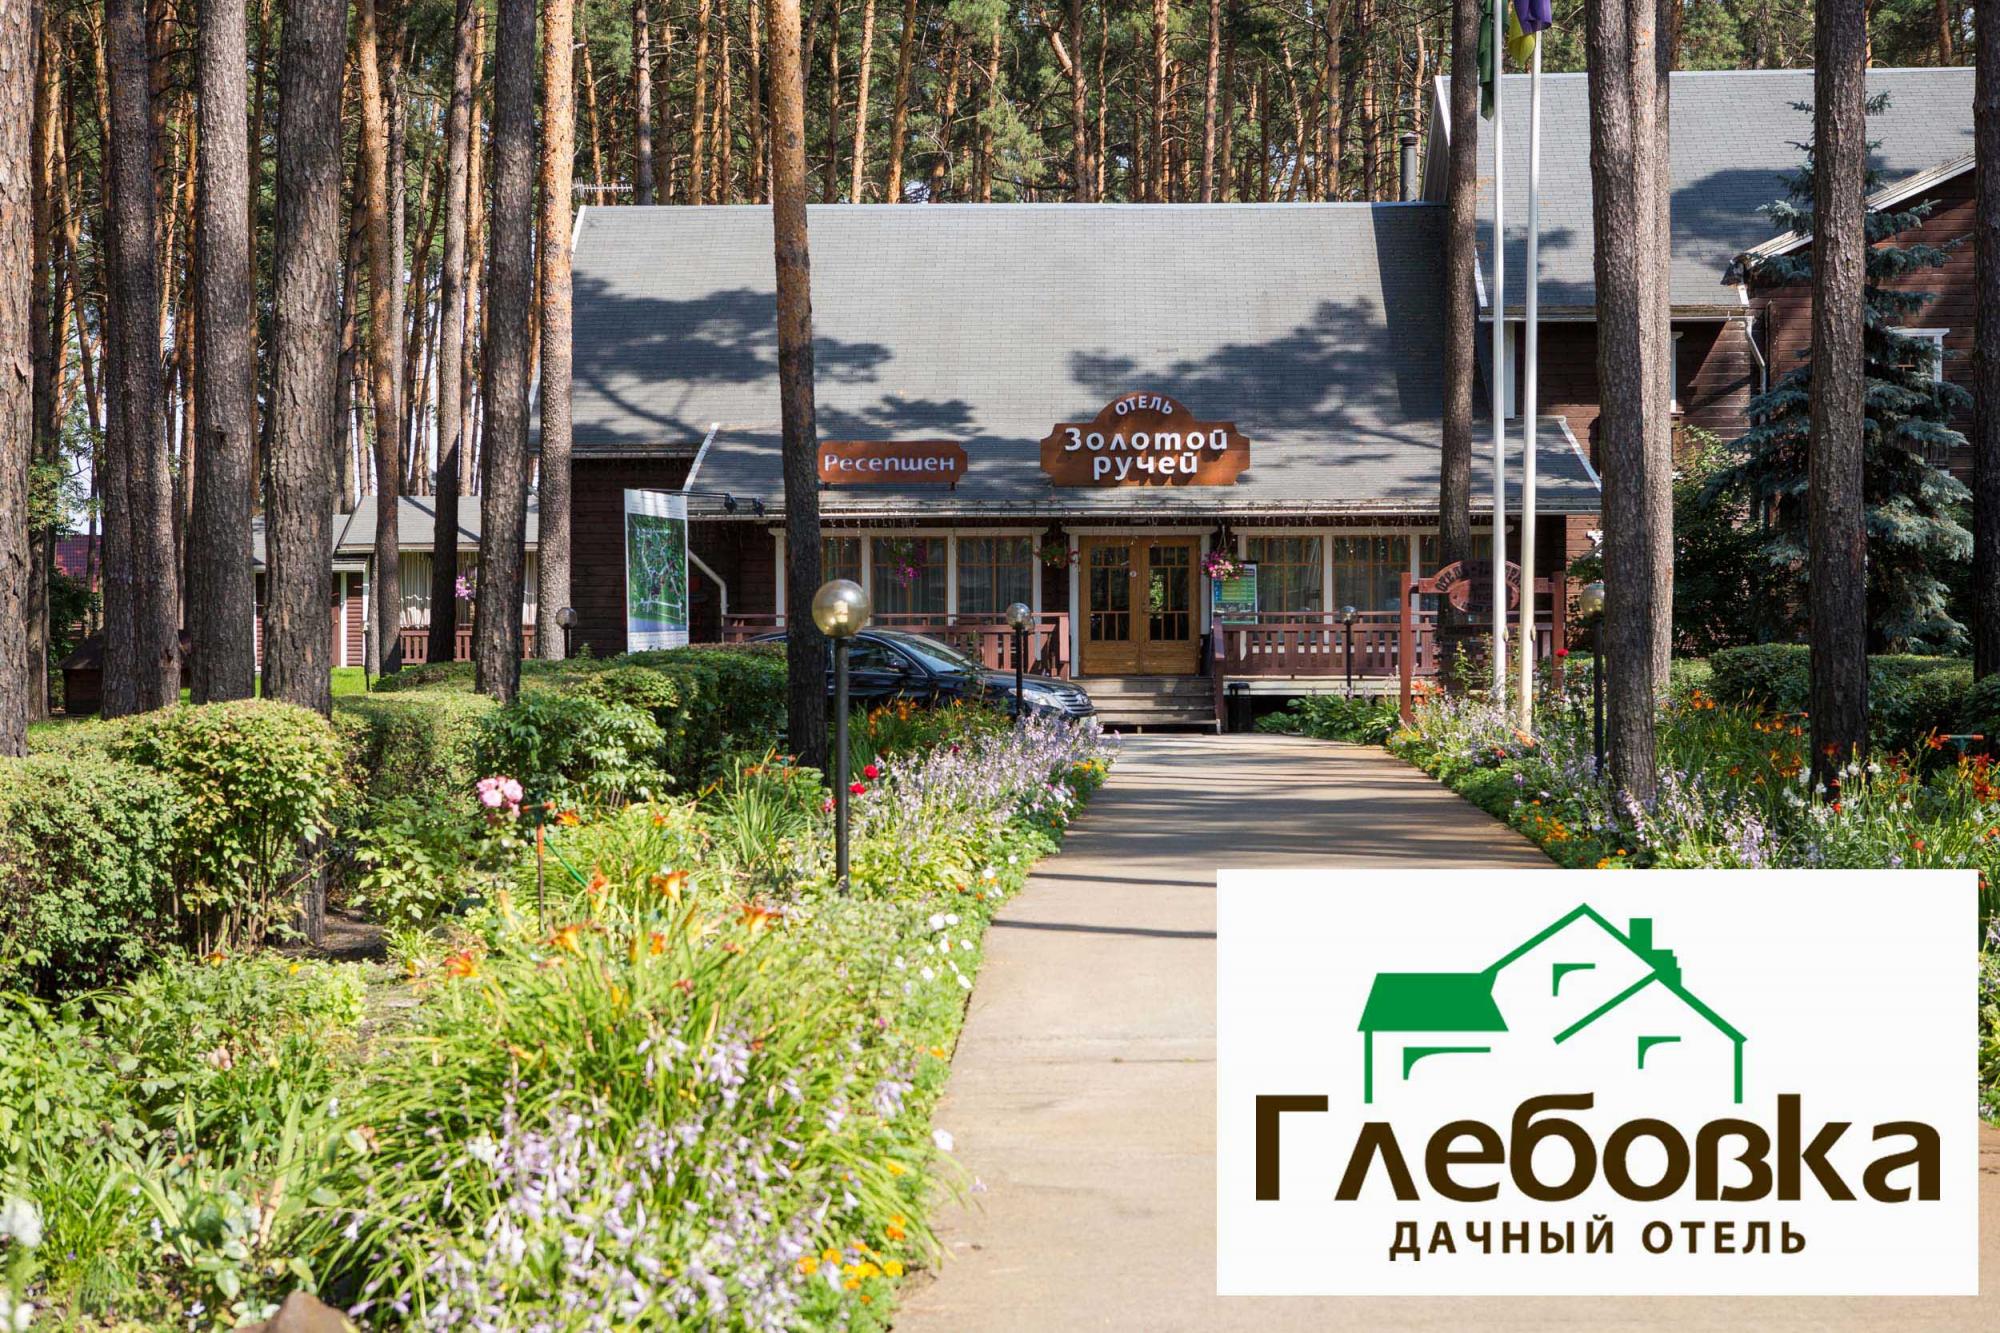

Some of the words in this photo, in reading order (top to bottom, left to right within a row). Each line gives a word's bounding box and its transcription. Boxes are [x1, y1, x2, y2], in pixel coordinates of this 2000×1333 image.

[1114, 395, 1174, 416] ОТЕЛЬ
[1064, 427, 1228, 452] Золотой
[824, 455, 954, 473] Ресепшен
[1093, 452, 1198, 480] ручей
